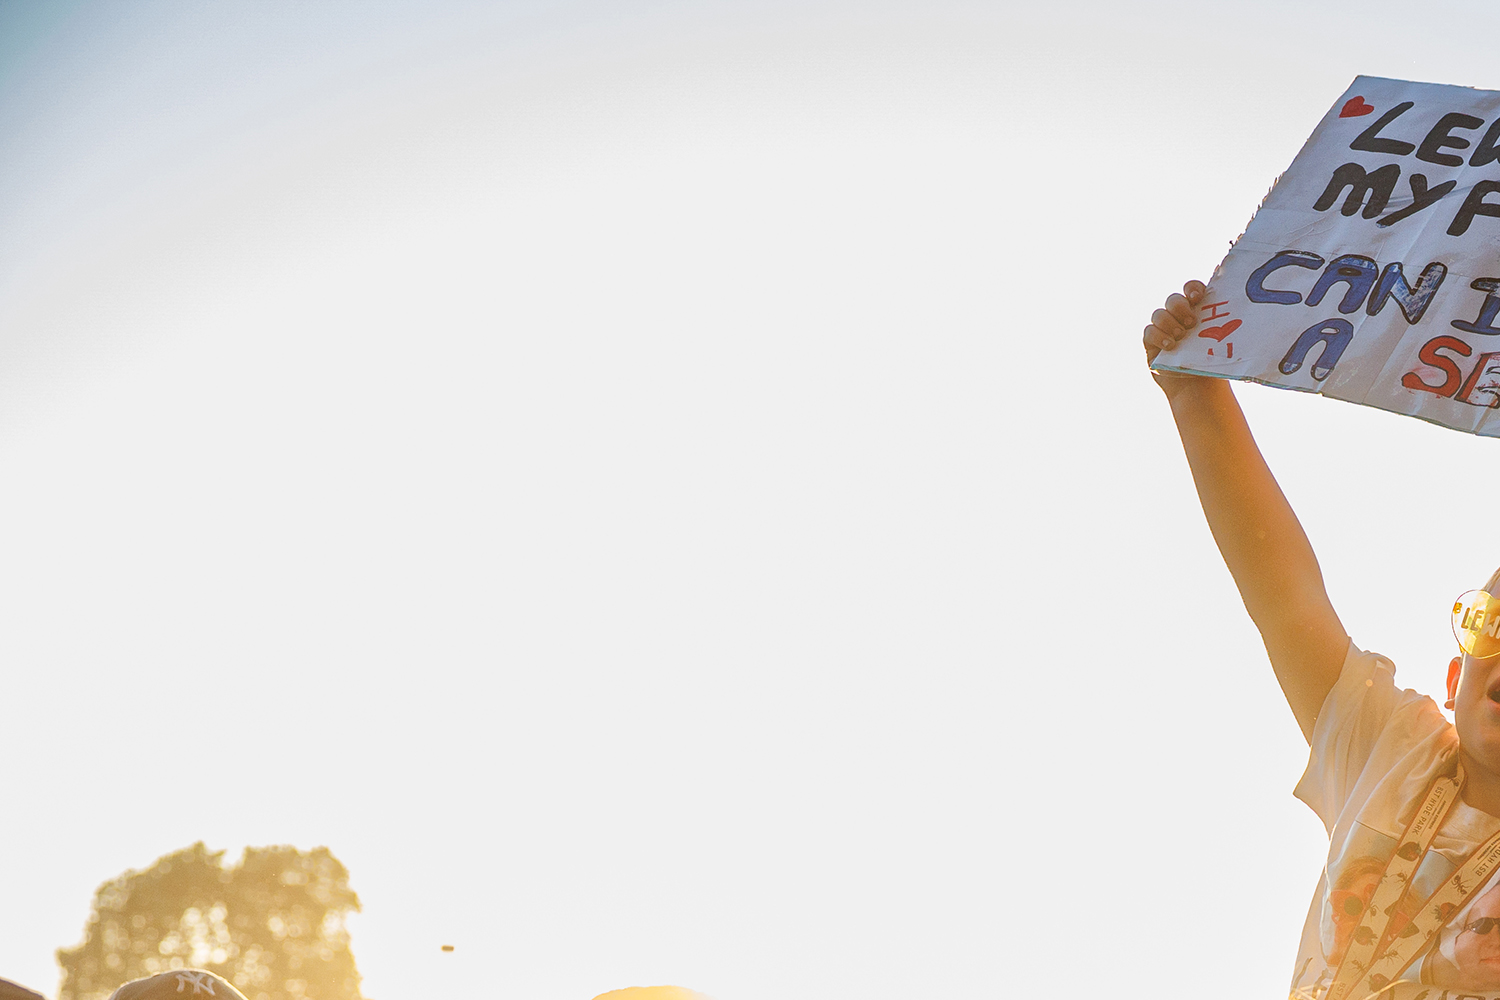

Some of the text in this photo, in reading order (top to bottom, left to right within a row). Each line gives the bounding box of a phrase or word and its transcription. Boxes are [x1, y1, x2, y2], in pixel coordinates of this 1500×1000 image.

[1312, 162, 1457, 228] MY
[1245, 250, 1448, 325] CAN
[1278, 317, 1354, 382] A
[1411, 816, 1426, 836] PARK
[1422, 798, 1437, 816] HYDE
[1475, 863, 1489, 877] BST
